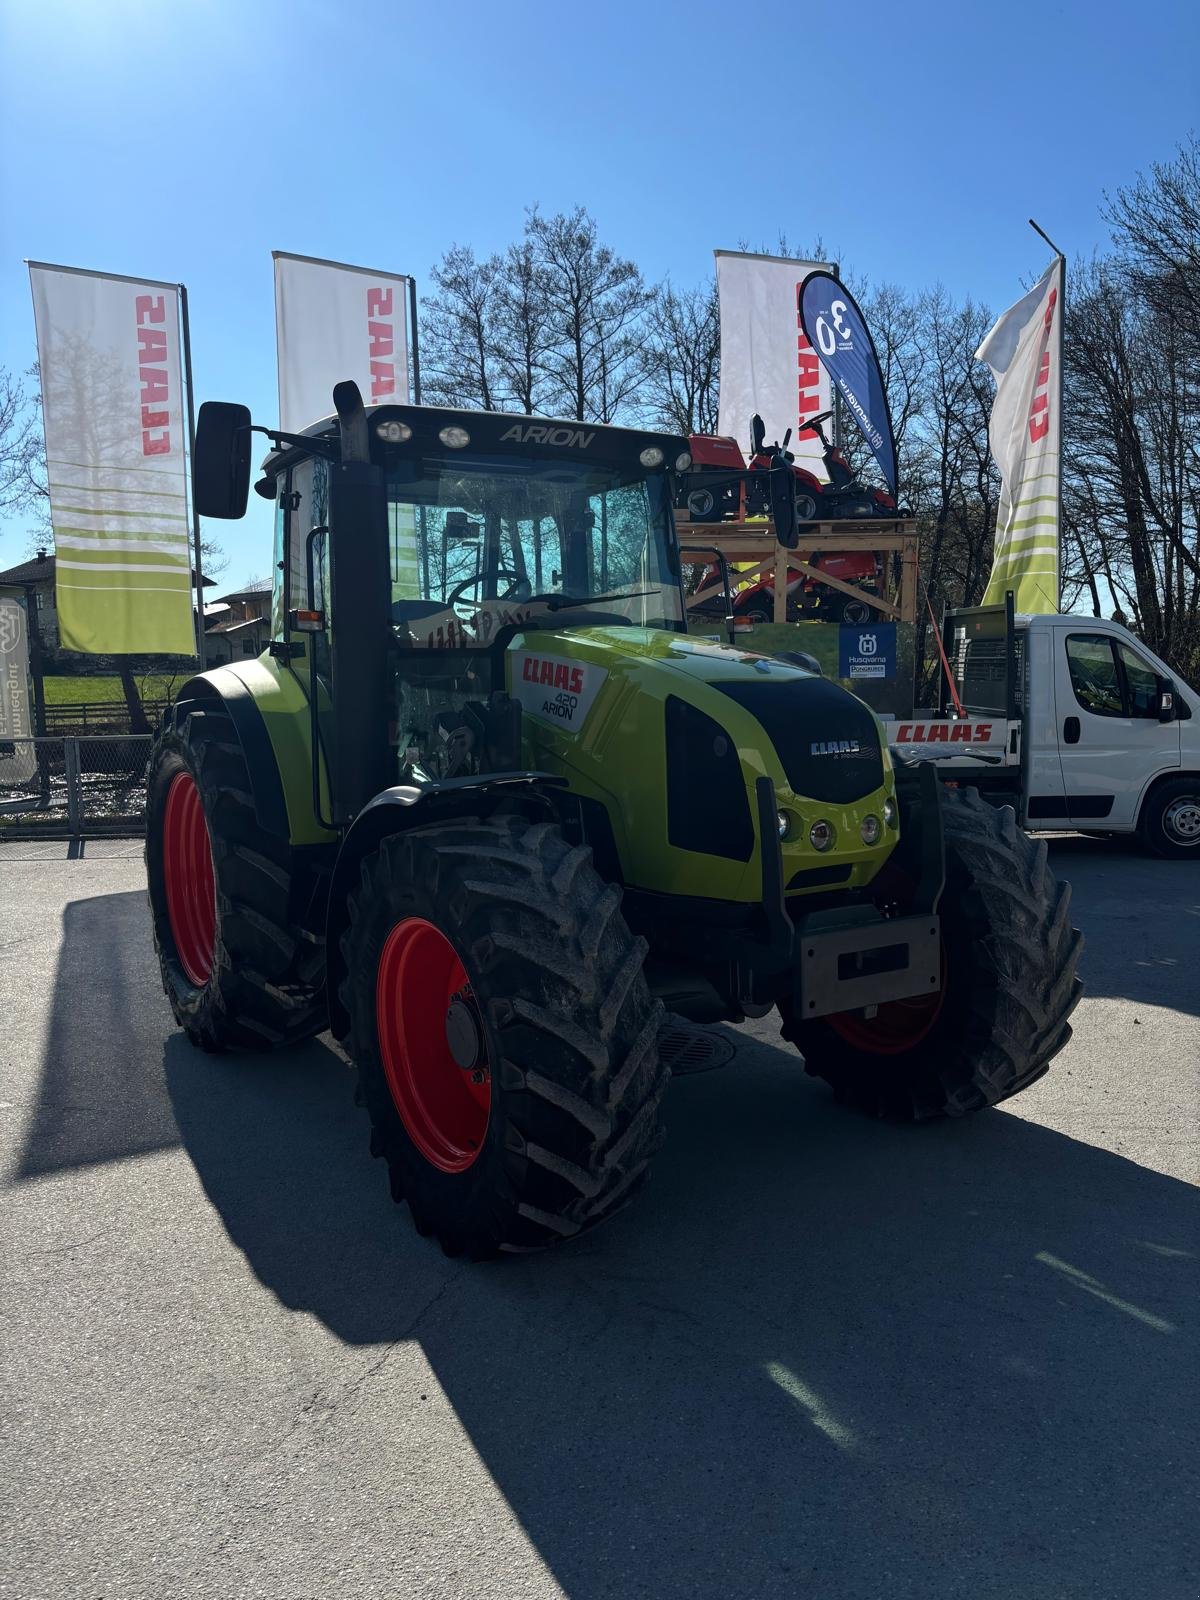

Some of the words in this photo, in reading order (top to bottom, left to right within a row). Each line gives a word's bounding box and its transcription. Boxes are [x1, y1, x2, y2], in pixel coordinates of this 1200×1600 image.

[499, 424, 596, 449] ARION
[848, 656, 887, 664] Husqvarna
[522, 657, 584, 694] CLAAS
[555, 692, 578, 709] 420
[541, 701, 574, 721] ARION
[895, 724, 993, 742] CLAAS
[810, 740, 860, 755] CLAAS
